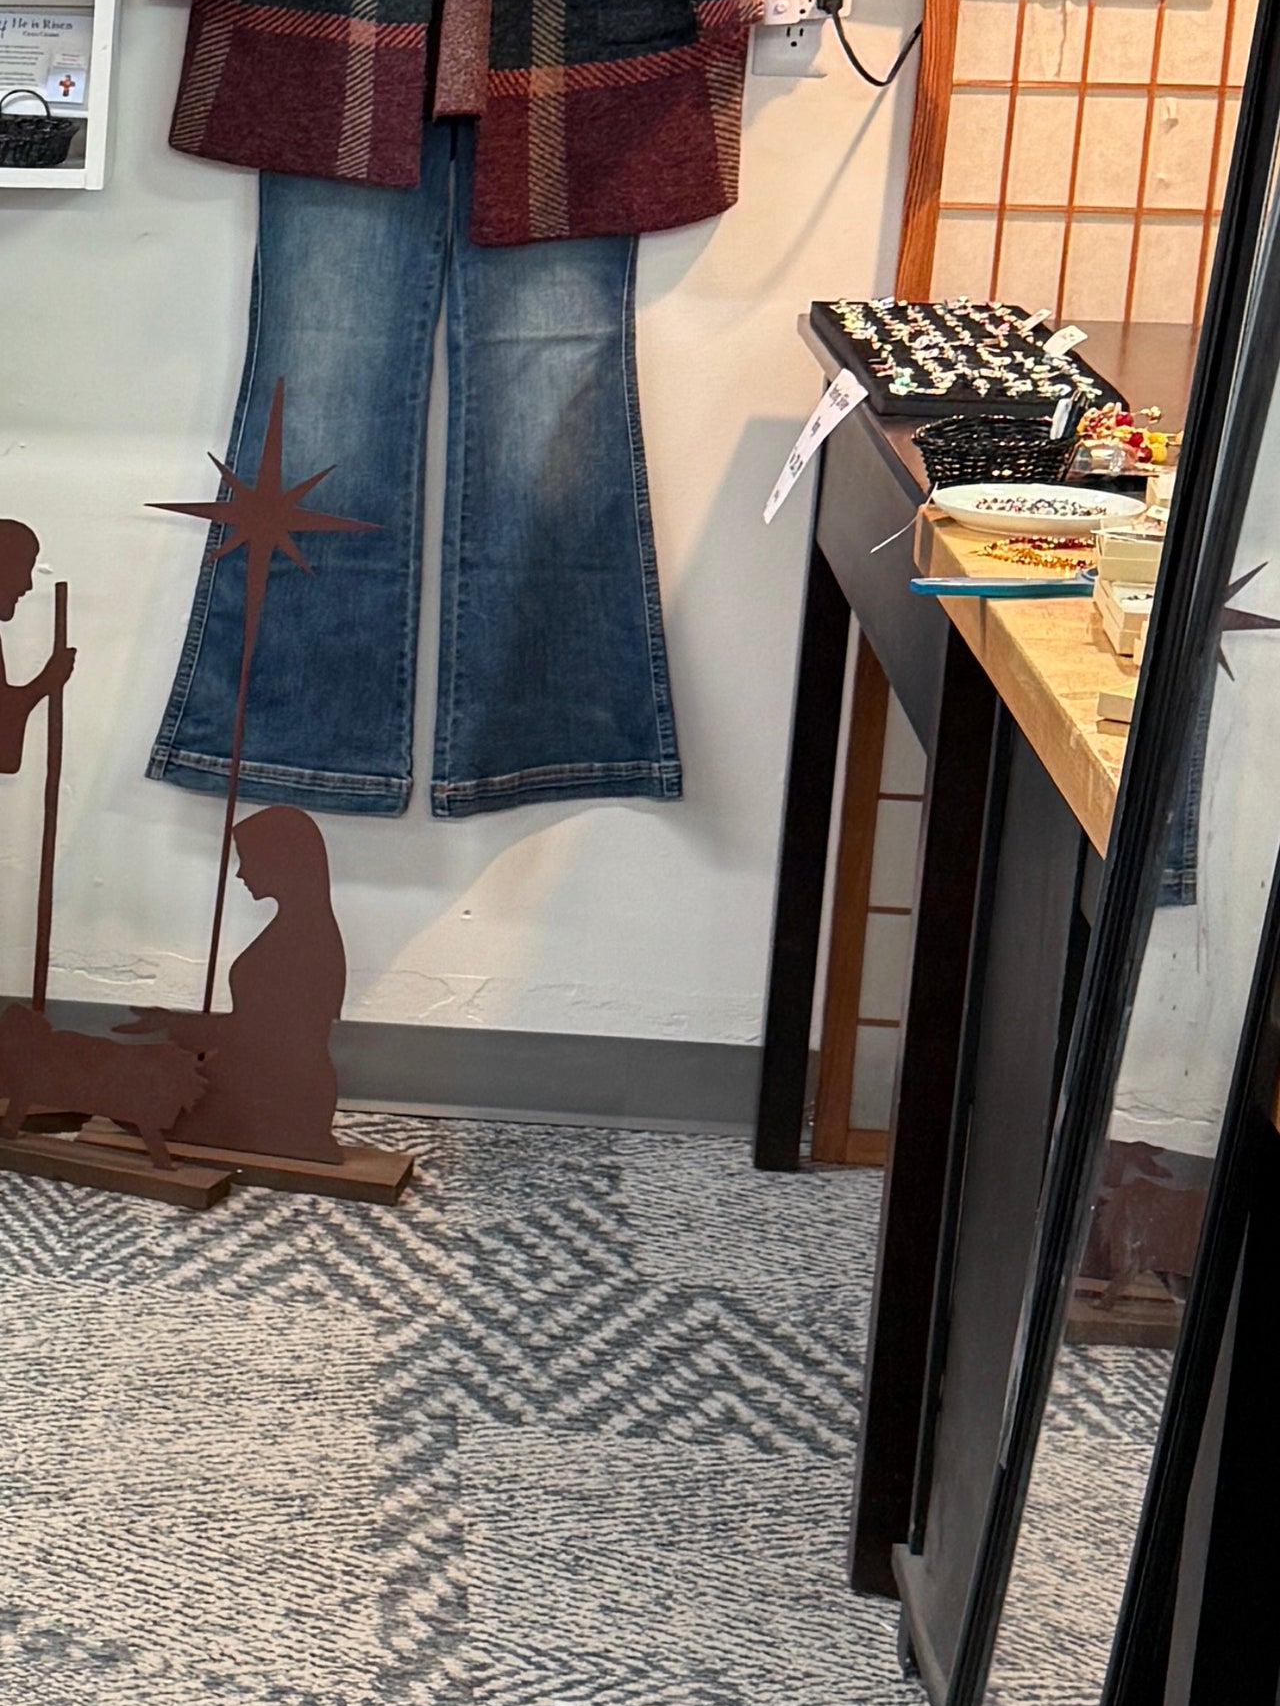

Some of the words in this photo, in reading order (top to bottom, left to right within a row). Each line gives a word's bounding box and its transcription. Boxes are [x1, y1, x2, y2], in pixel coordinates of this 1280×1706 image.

[11, 17, 28, 30] He
[31, 19, 40, 30] is
[42, 18, 73, 31] Risen
